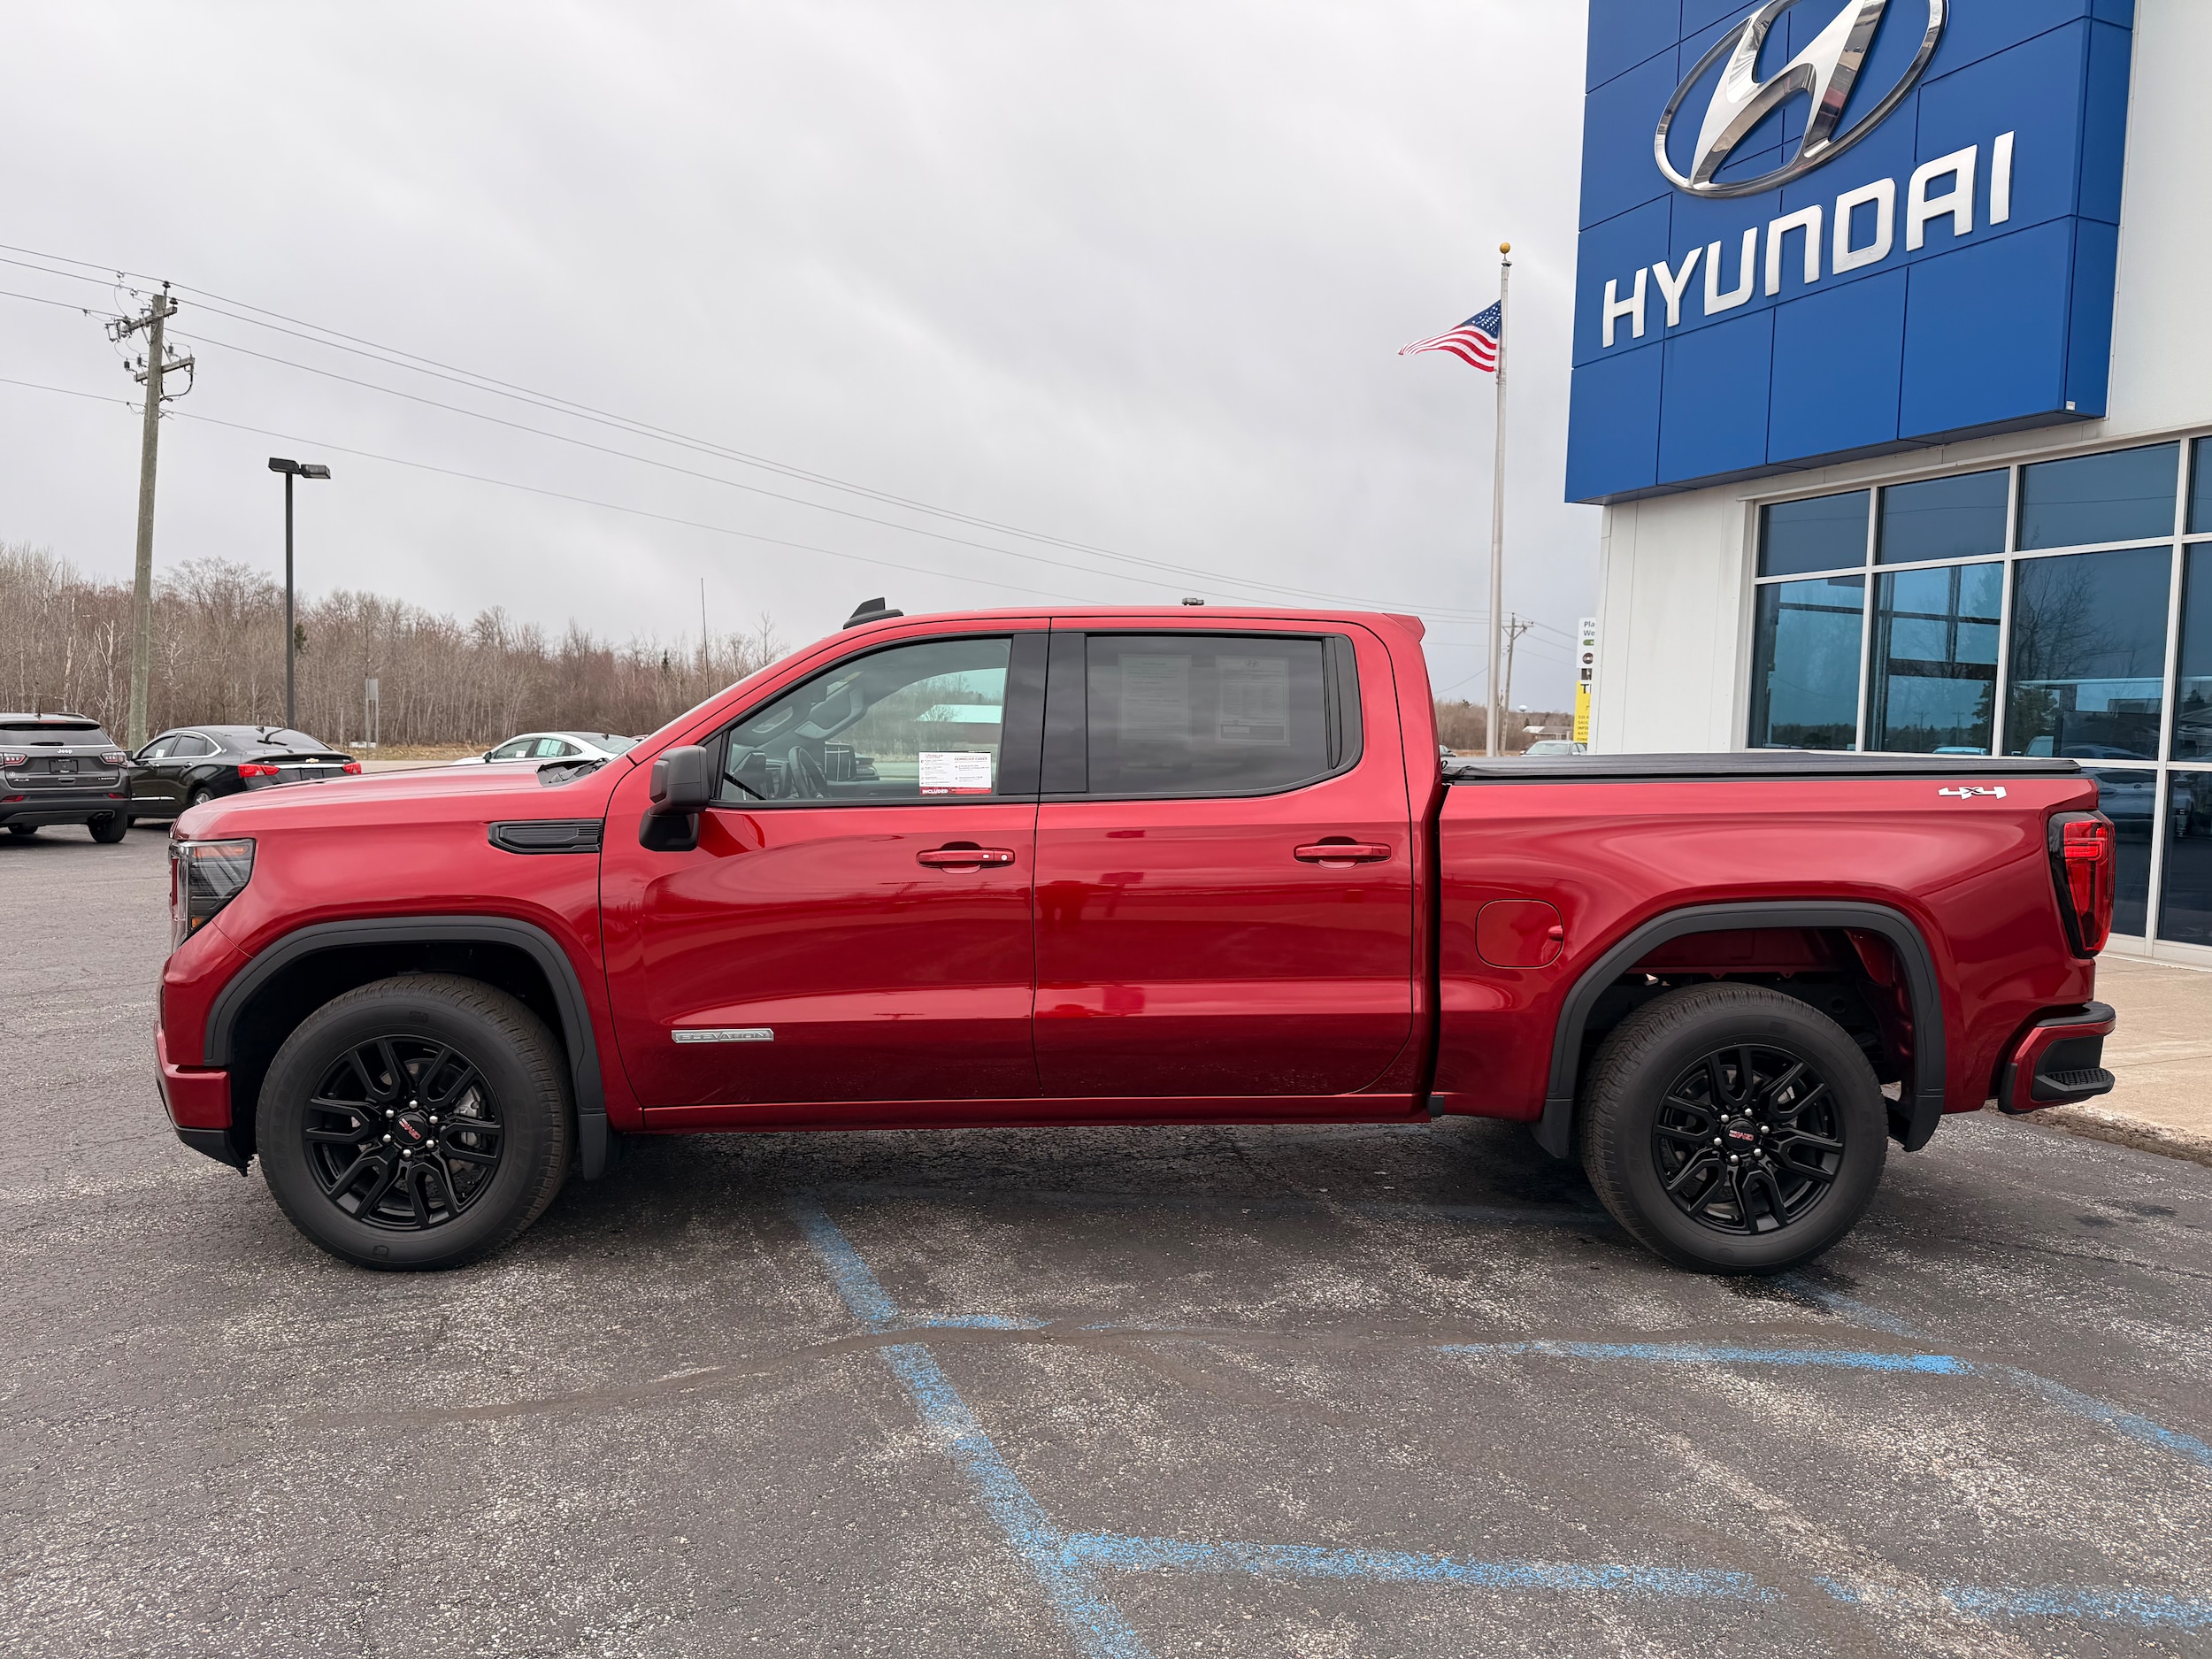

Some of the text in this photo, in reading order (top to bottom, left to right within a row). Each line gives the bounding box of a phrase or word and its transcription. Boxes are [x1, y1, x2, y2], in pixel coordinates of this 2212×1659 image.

[1602, 130, 2016, 348] HYUNDAI
[679, 1030, 769, 1042] ELEVATION
[399, 1118, 422, 1141] GMC
[1728, 1129, 1755, 1141] GMC
